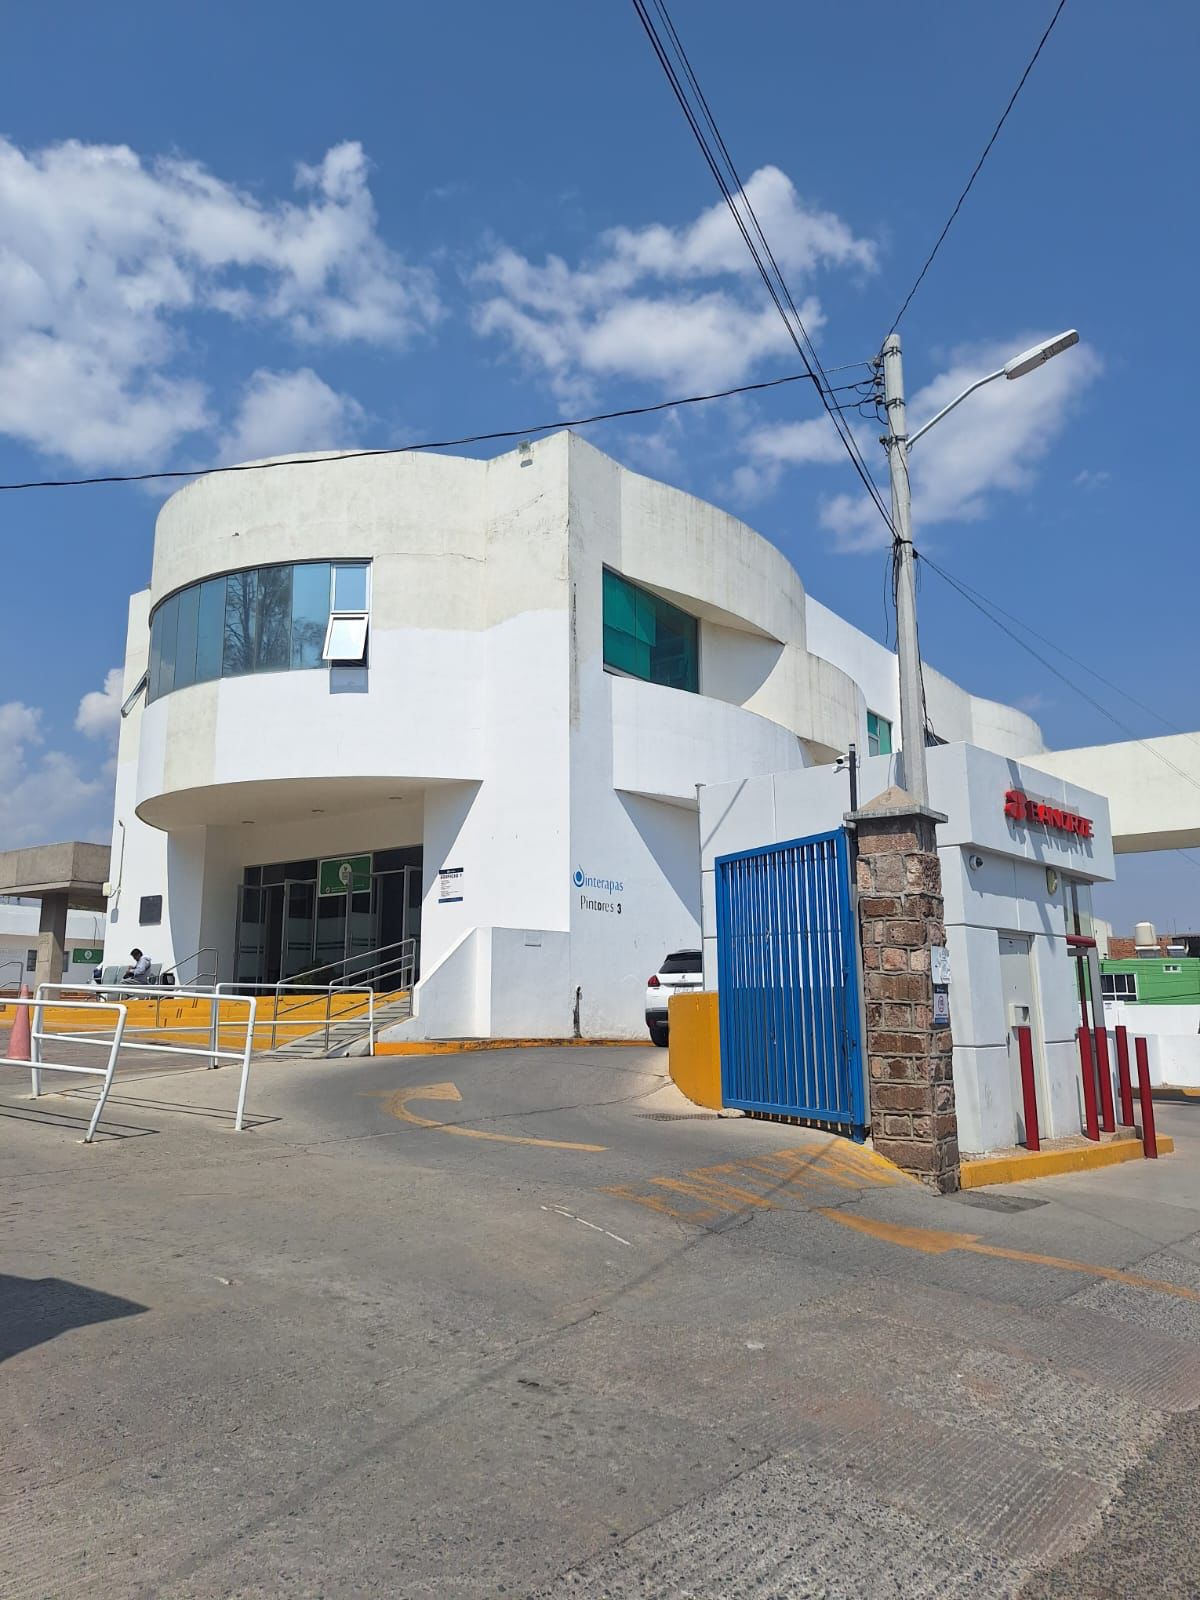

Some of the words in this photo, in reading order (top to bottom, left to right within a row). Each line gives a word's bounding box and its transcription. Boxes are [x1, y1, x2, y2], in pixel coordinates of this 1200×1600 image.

[585, 876, 624, 895] interapas
[580, 895, 614, 912] Pintores
[617, 903, 622, 914] 3
